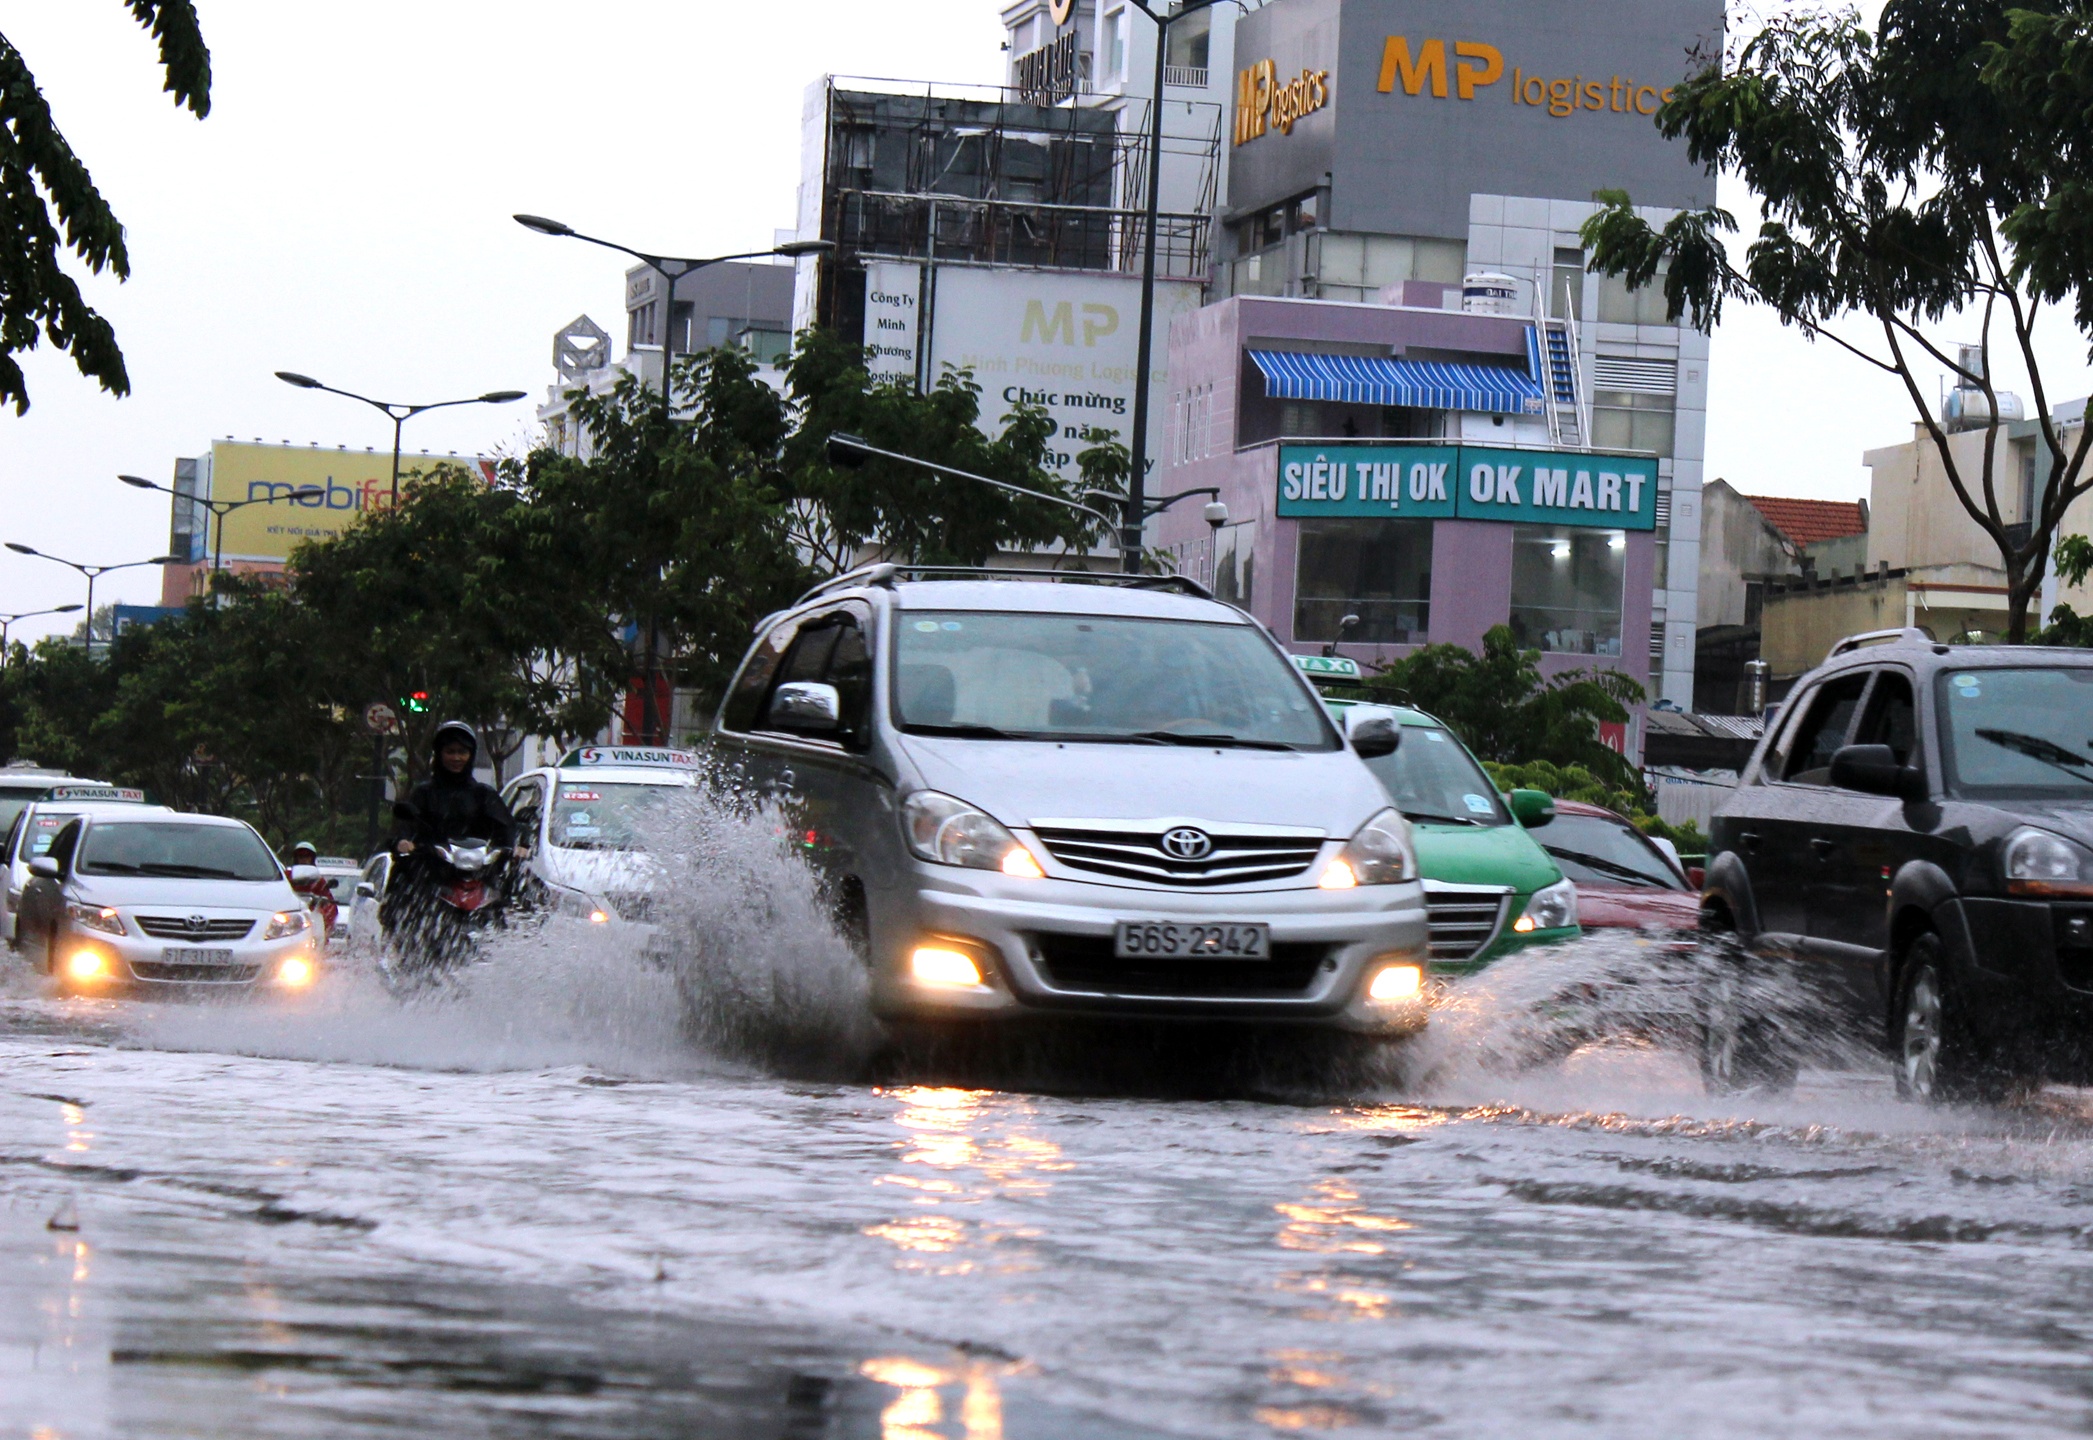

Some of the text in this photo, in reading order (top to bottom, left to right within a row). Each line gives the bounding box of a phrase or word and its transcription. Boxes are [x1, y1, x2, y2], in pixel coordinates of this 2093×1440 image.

[1377, 35, 1505, 100] MP
[1234, 59, 1328, 147] MP logistics
[870, 291, 915, 309] Công Ty
[877, 318, 906, 331] Minh
[1020, 299, 1120, 347] MP
[1003, 386, 1126, 415] Chúc mừng
[1284, 454, 1448, 510] SIÊU THỊ OK
[1470, 464, 1645, 513] OK MART
[612, 751, 669, 763] VINASUN
[72, 789, 141, 799] VINASUN TAXI
[1126, 924, 1259, 955] 56S-2342
